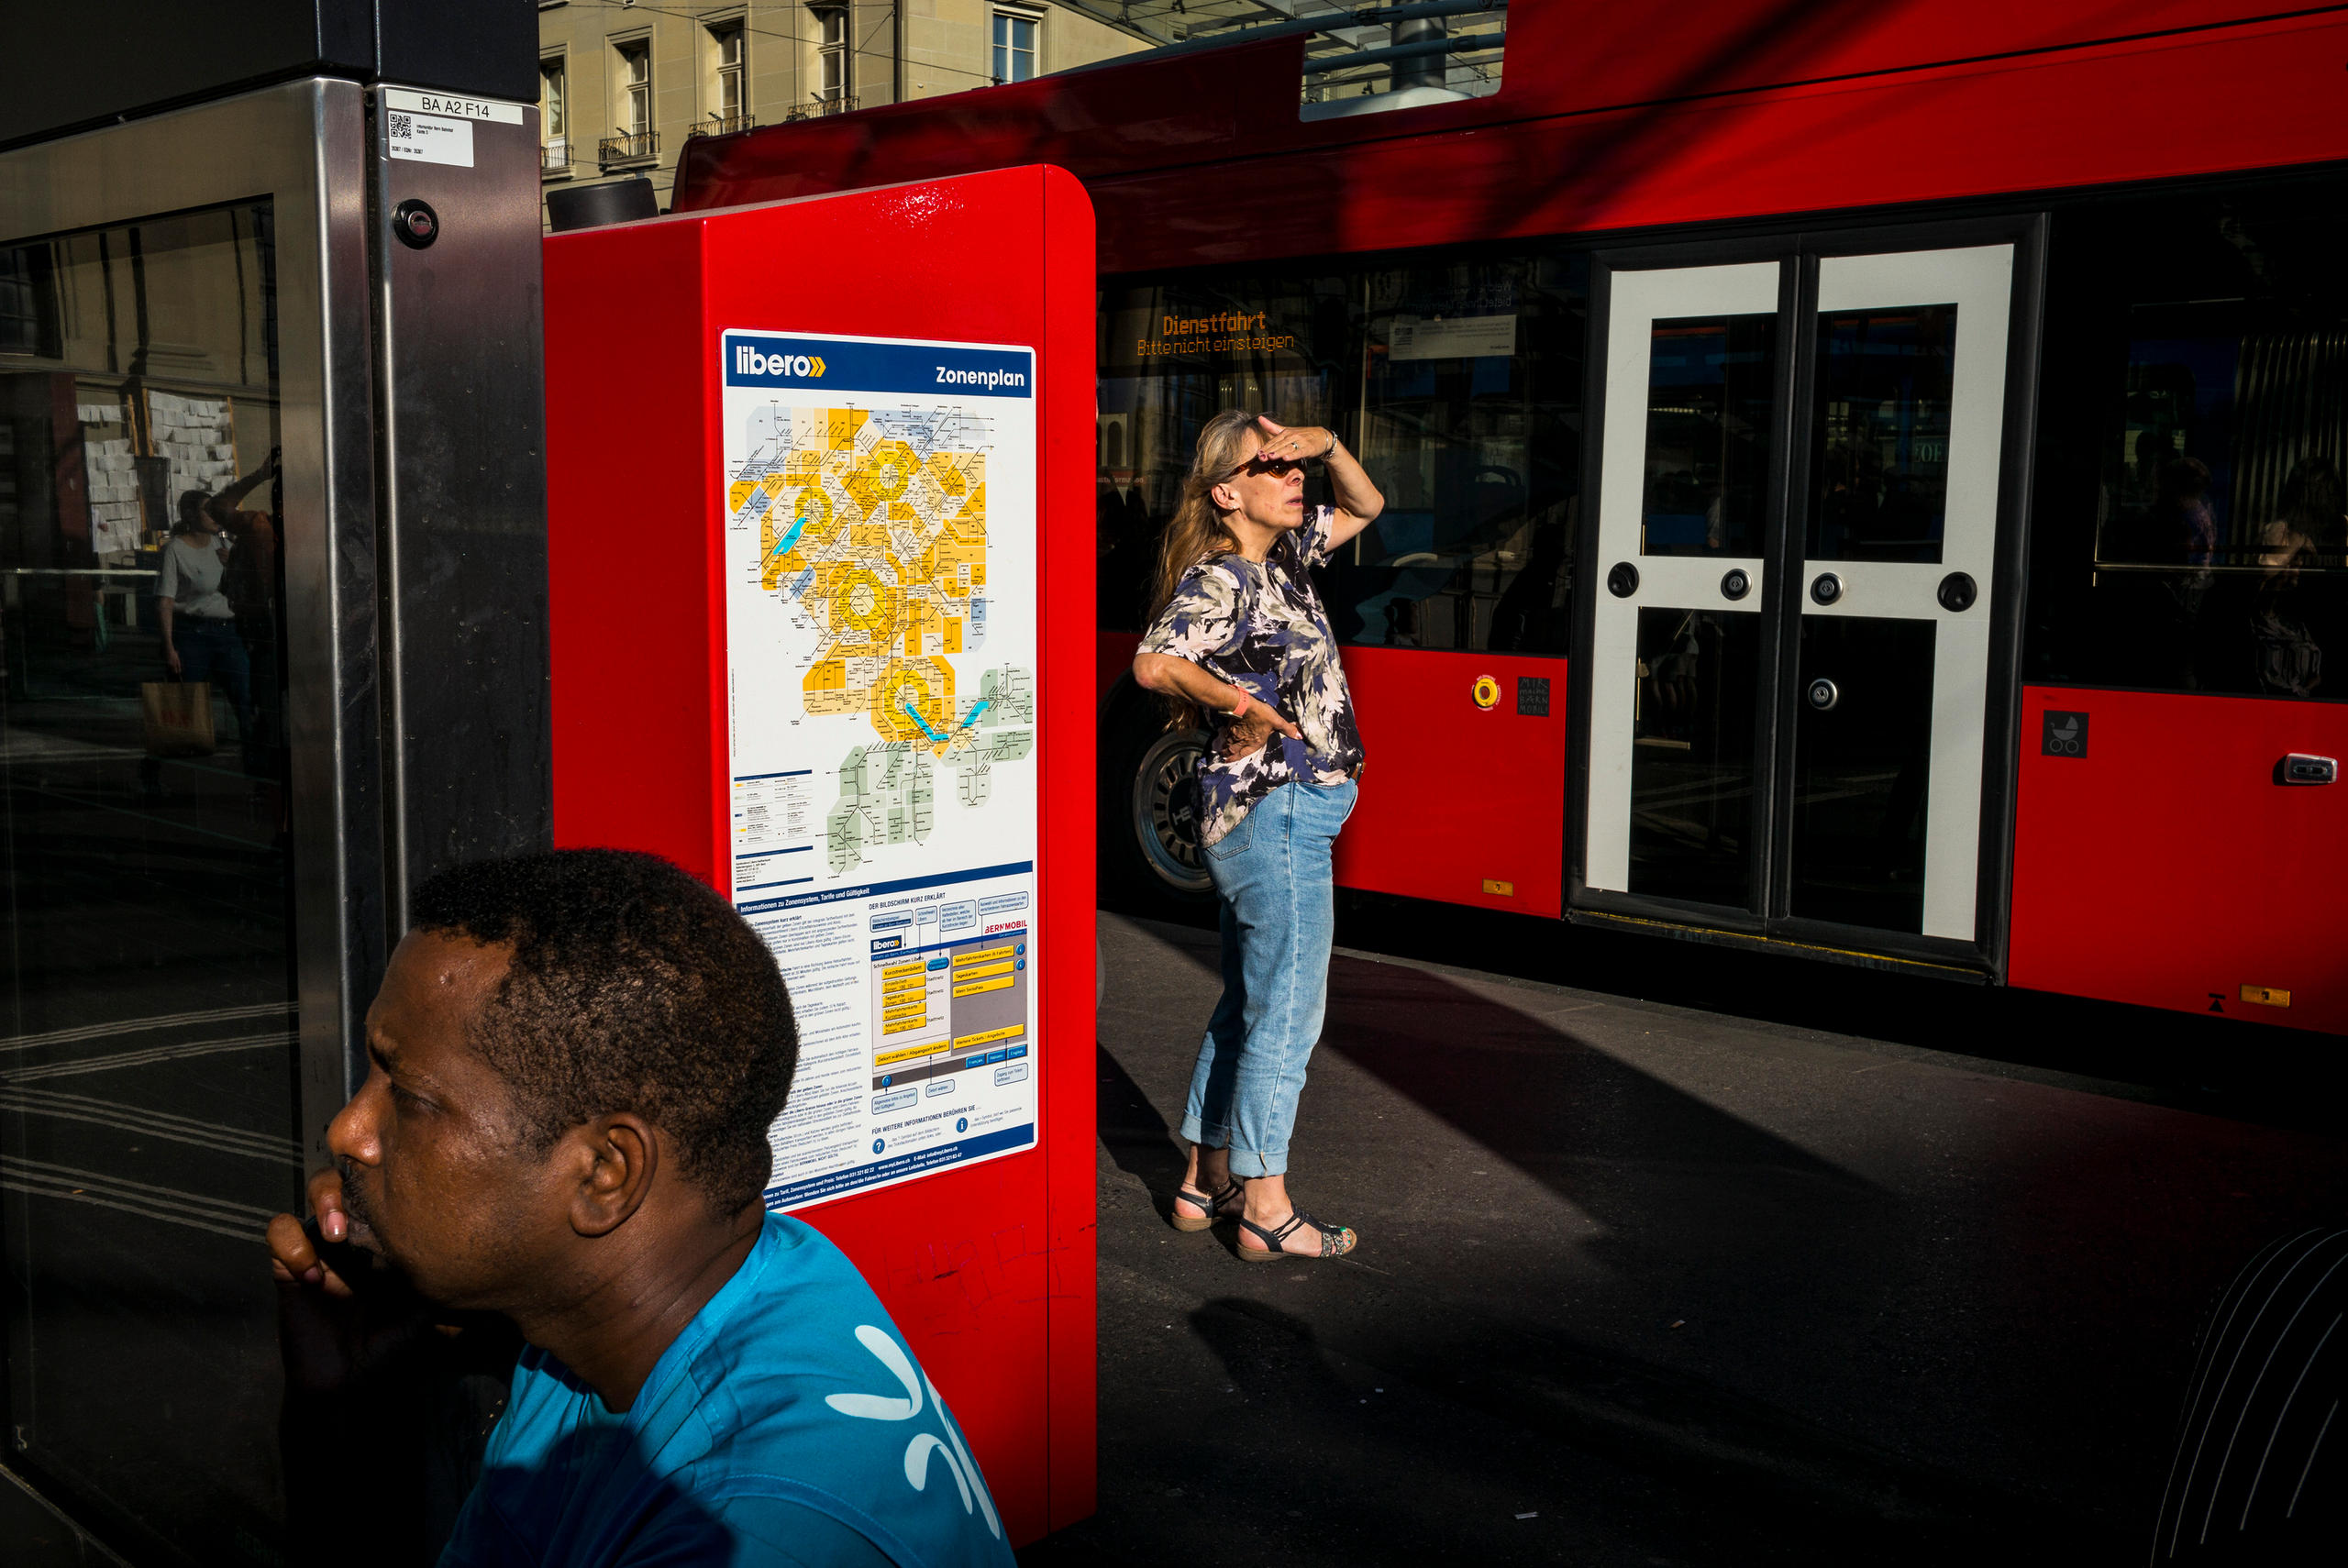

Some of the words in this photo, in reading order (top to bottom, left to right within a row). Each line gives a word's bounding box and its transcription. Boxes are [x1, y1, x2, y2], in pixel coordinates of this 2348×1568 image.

[423, 97, 440, 111] BA
[445, 101, 461, 114] A2
[466, 103, 489, 117] F14
[1163, 311, 1266, 336] Dienstfahrt
[1137, 339, 1172, 356] Bitte
[1174, 337, 1211, 354] nicht
[1213, 334, 1294, 352] einsteigen
[736, 346, 813, 377] libero
[936, 366, 1024, 391] Zonenplan
[741, 902, 777, 912] Informationen
[785, 896, 820, 906] Zonensystem,
[821, 892, 835, 900] Tarife
[846, 888, 869, 898] Gültigkeit
[880, 899, 909, 908] BILDSCHIRM
[925, 892, 946, 901] ERKLÄRT
[873, 941, 895, 950] libero
[871, 1127, 882, 1135] FÜR
[882, 1122, 903, 1132] WEITERE
[904, 1113, 942, 1127] INFORMATIONEN
[943, 1107, 967, 1118] BERÜHREN
[791, 1183, 815, 1193] Zonensystem
